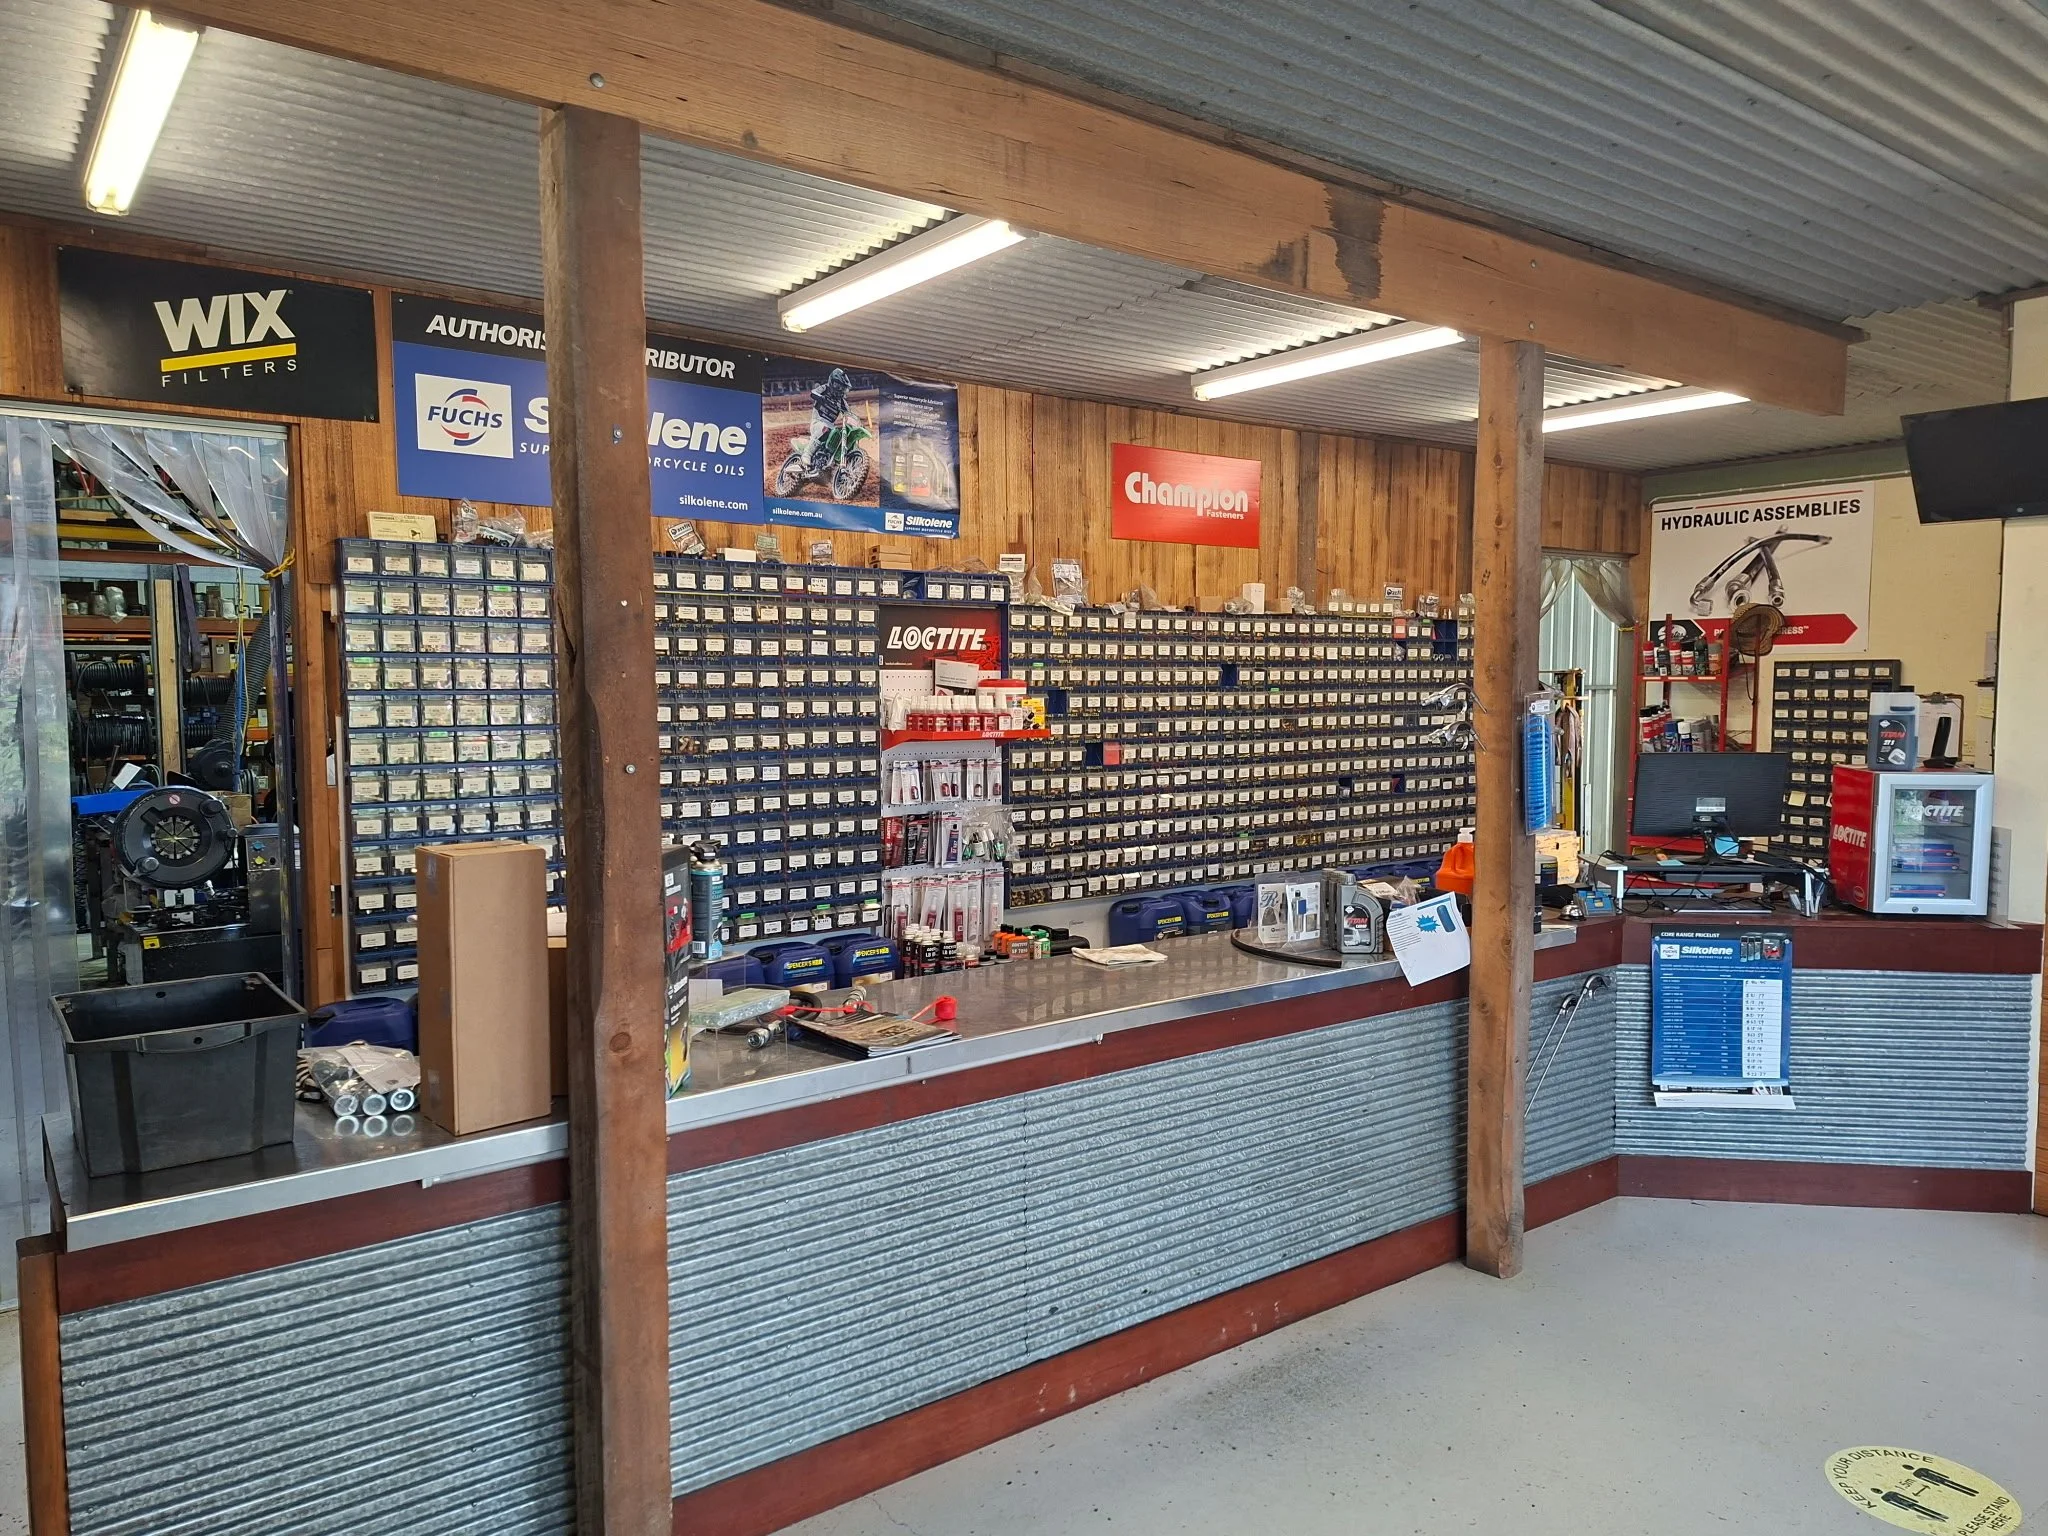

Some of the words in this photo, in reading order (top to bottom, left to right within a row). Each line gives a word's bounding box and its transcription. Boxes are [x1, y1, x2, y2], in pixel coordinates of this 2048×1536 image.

[154, 289, 295, 352] WIX
[161, 359, 298, 388] FILTERS
[646, 348, 736, 379] RIBUTOR
[427, 405, 503, 429] FUCHS
[714, 463, 746, 477] OILS
[679, 495, 749, 512] silkolene.com
[1124, 471, 1248, 517] Champion
[772, 507, 823, 519] silkolene.com.au
[905, 515, 953, 529] Silkolene
[1206, 509, 1244, 520] Fasteners
[1661, 509, 1749, 531] HYDRAULIC
[1753, 499, 1861, 522] ASSEMBLIES
[887, 625, 986, 651] LOCTITE
[981, 731, 1005, 739] LOCTITE
[1832, 824, 1867, 849] LOCTITE
[1681, 945, 1734, 956] Silkolene
[1833, 1456, 1852, 1480] YOUR
[1848, 1448, 1934, 1464] DISTANCE
[1838, 1482, 1878, 1510] KEEP
[1958, 1512, 1988, 1536] PLEASE
[1983, 1495, 2010, 1518] STAND
[1987, 1513, 2012, 1531] HERE
